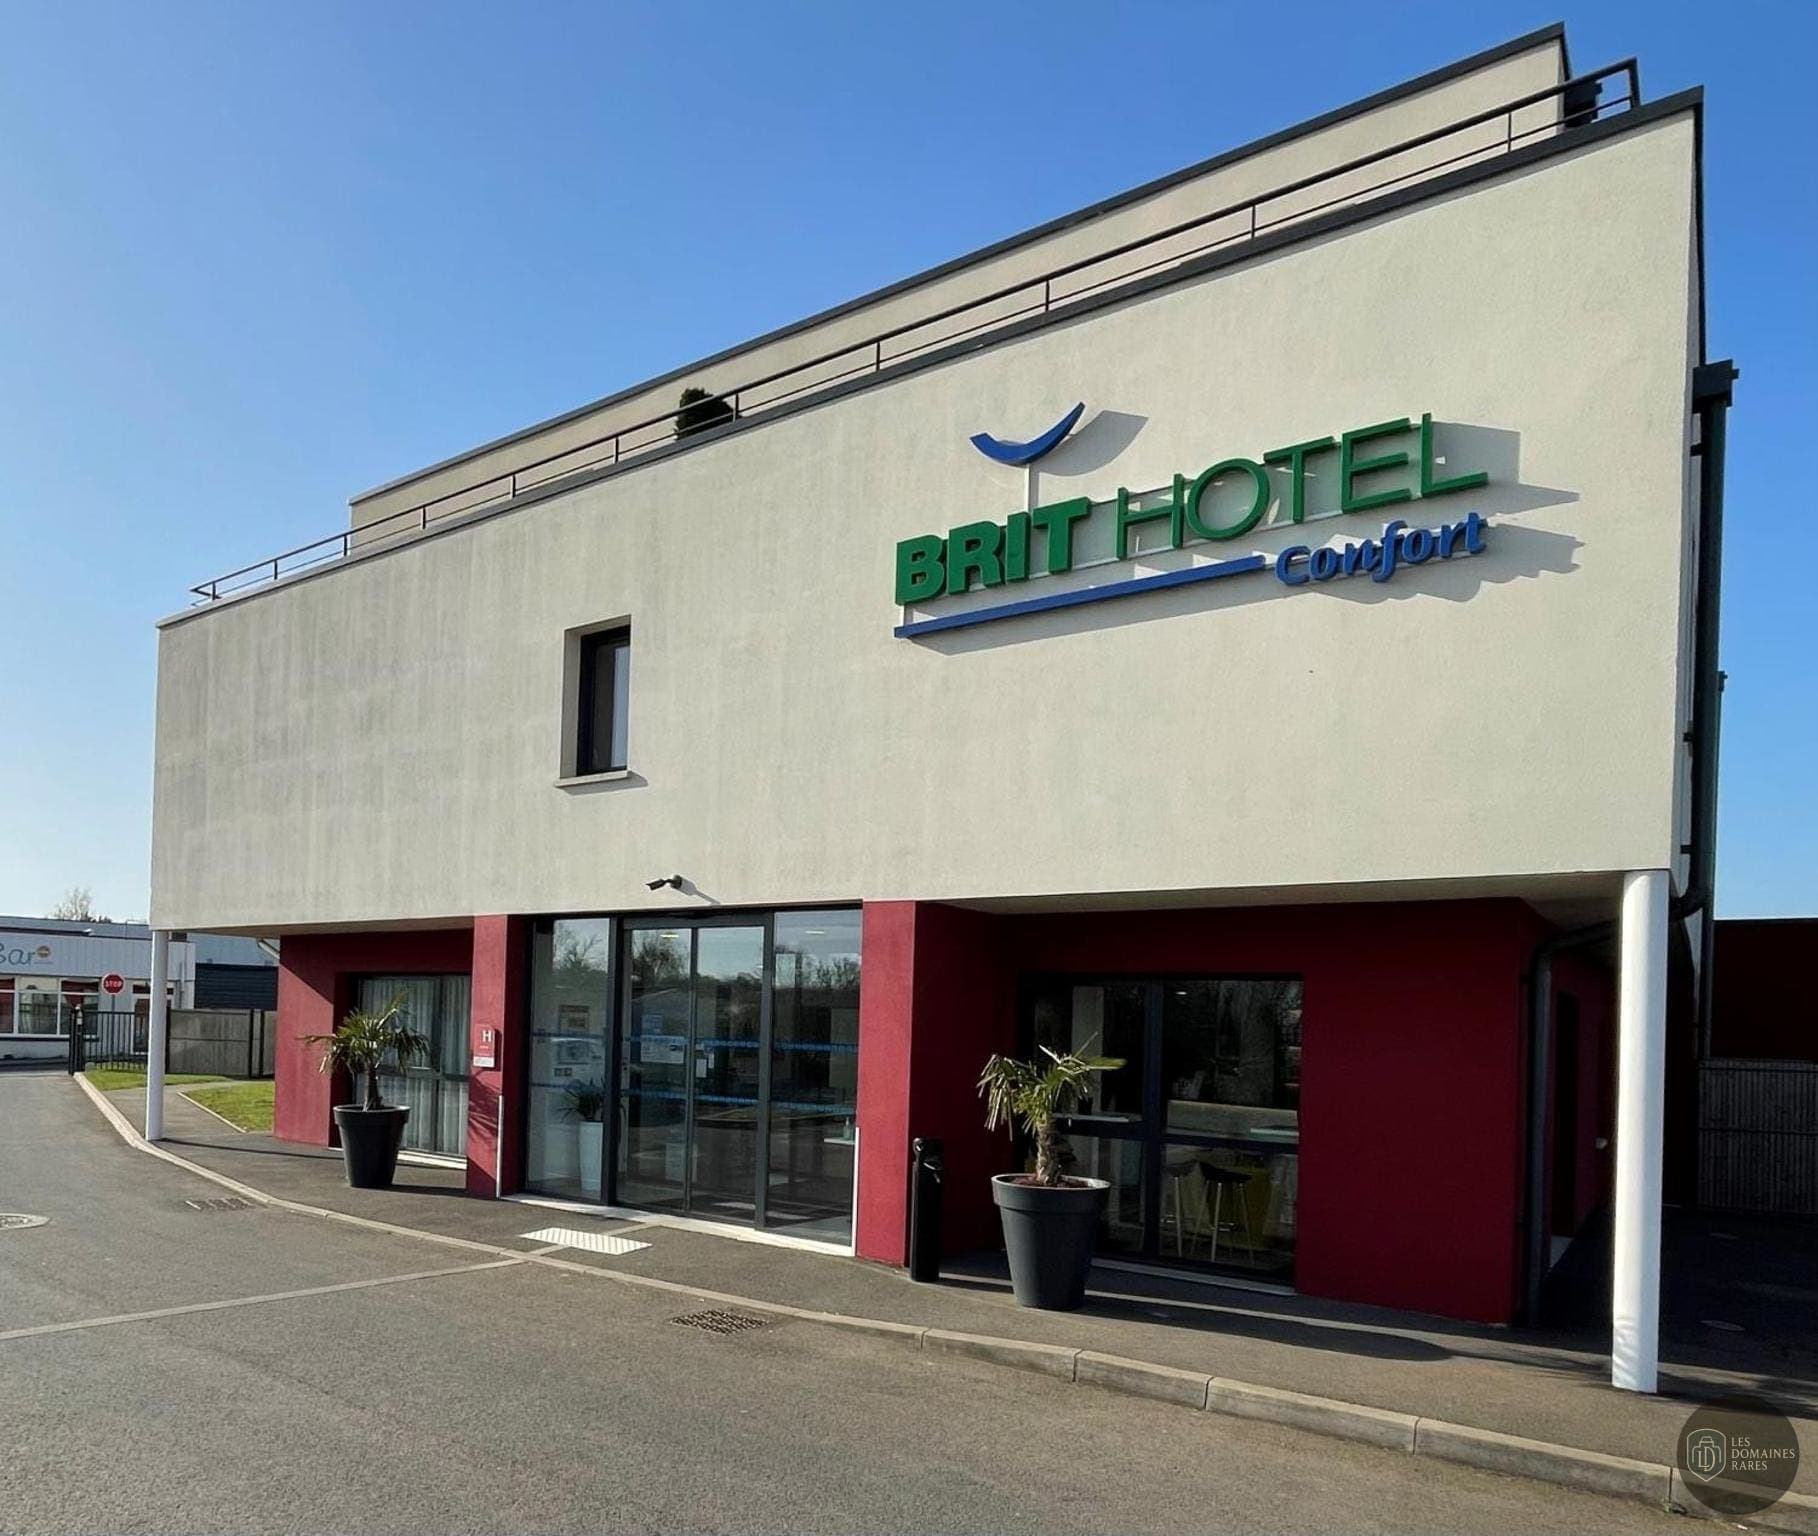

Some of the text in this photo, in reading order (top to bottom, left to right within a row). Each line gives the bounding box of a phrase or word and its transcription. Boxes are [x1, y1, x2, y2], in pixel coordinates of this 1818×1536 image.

[895, 413, 1488, 605] BRIT HOTEL
[105, 980, 123, 988] STOP
[482, 1030, 492, 1042] H
